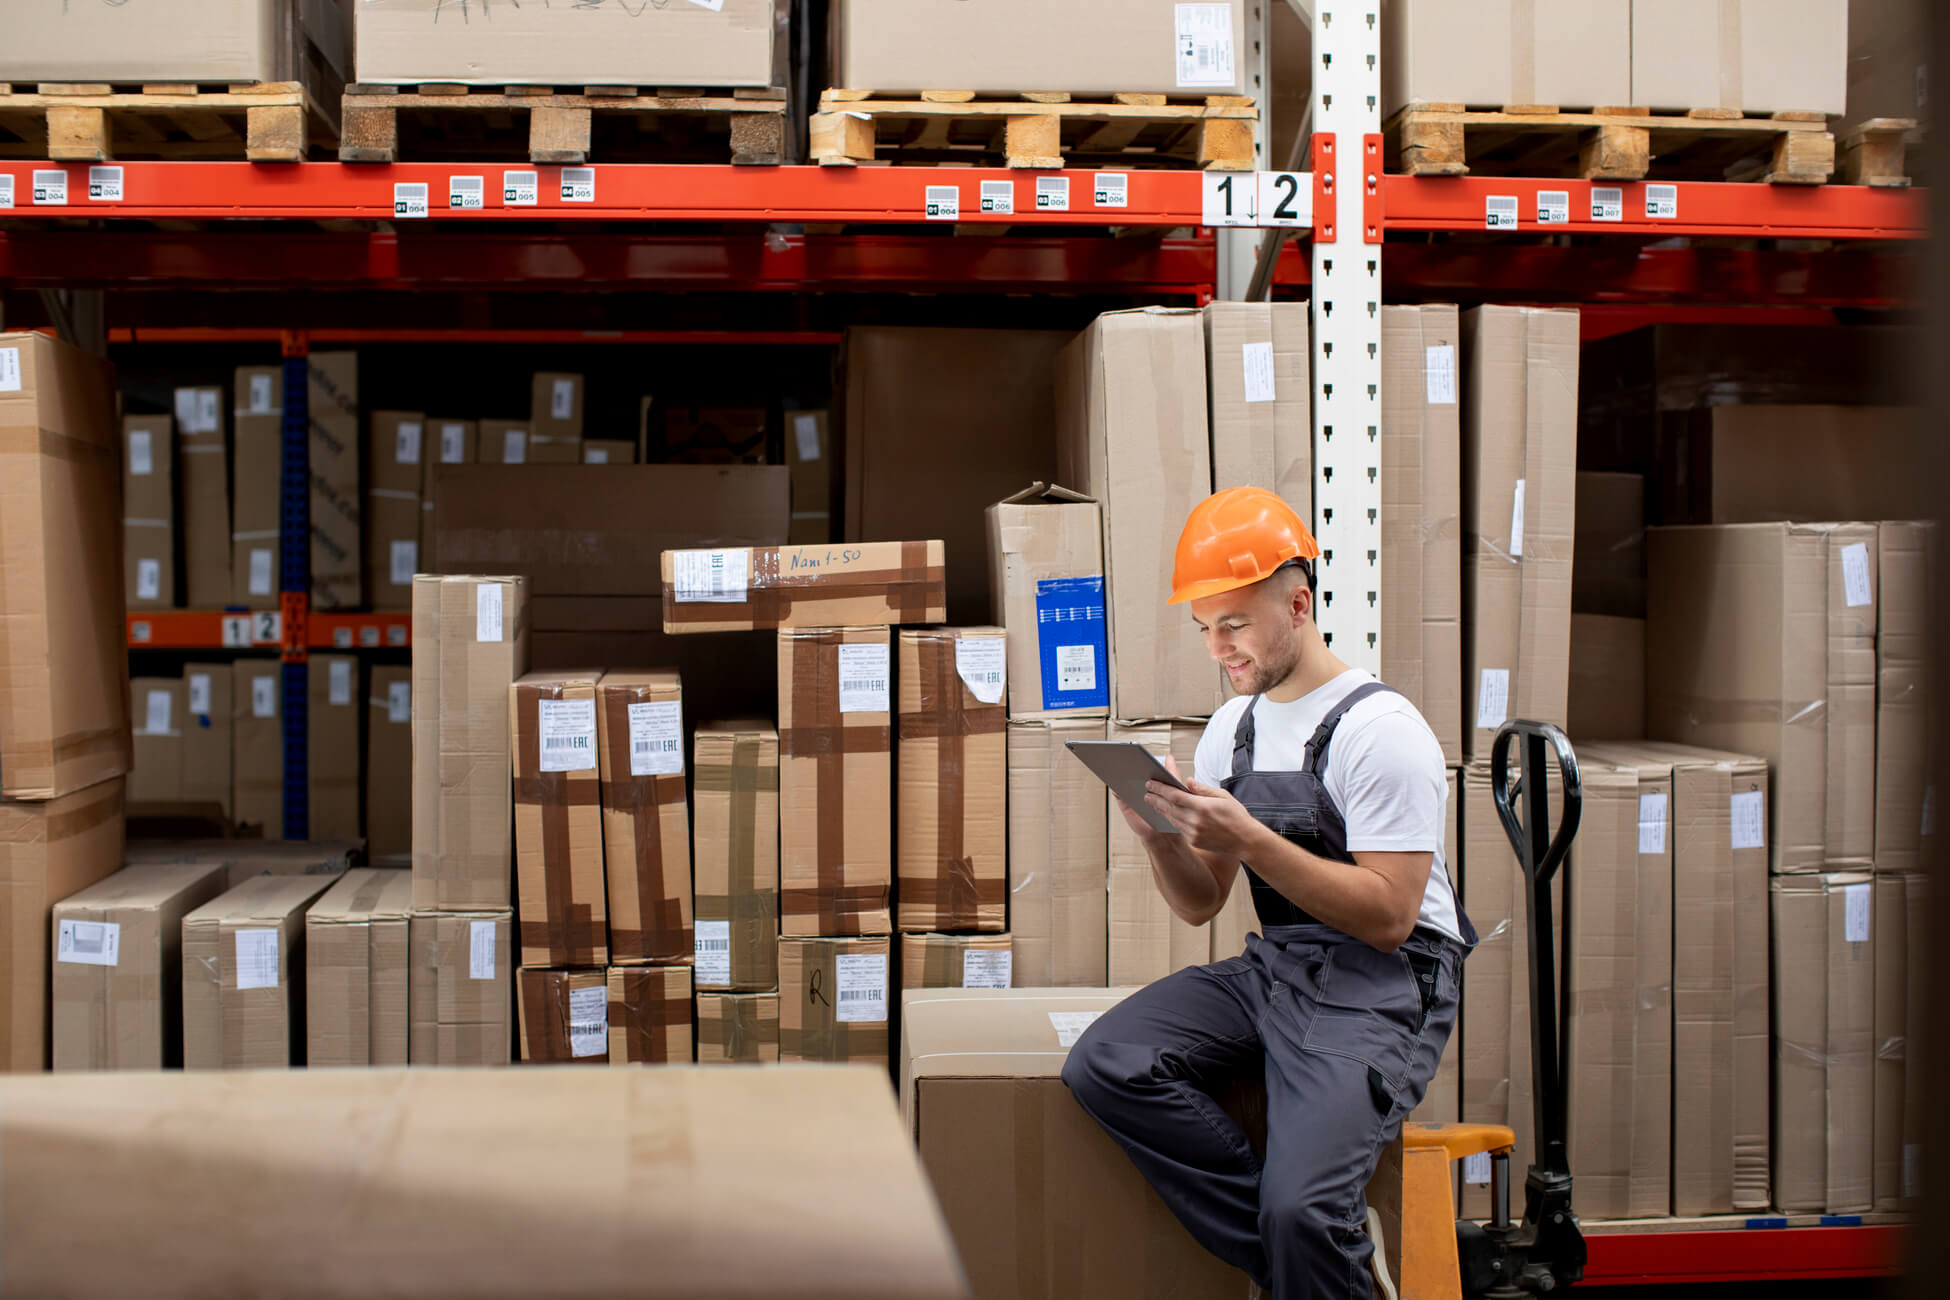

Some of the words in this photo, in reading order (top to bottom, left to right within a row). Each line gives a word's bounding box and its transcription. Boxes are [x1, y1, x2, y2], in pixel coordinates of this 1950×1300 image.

[518, 193, 534, 201] 005
[575, 190, 591, 198] 005
[1108, 195, 1124, 203] 006
[1217, 176, 1232, 216] 1
[1273, 174, 1298, 219] 2
[1050, 198, 1066, 207] 006
[940, 208, 956, 216] 004
[1551, 213, 1566, 221] 007
[711, 554, 723, 567] EAC
[230, 619, 239, 641] 1
[259, 613, 274, 639] 2
[987, 671, 1001, 683] EAC
[871, 680, 885, 691] EAC
[573, 736, 589, 749] EAC
[663, 739, 677, 752] EAC
[868, 989, 882, 1001] EAC
[588, 1023, 603, 1035] EAC
